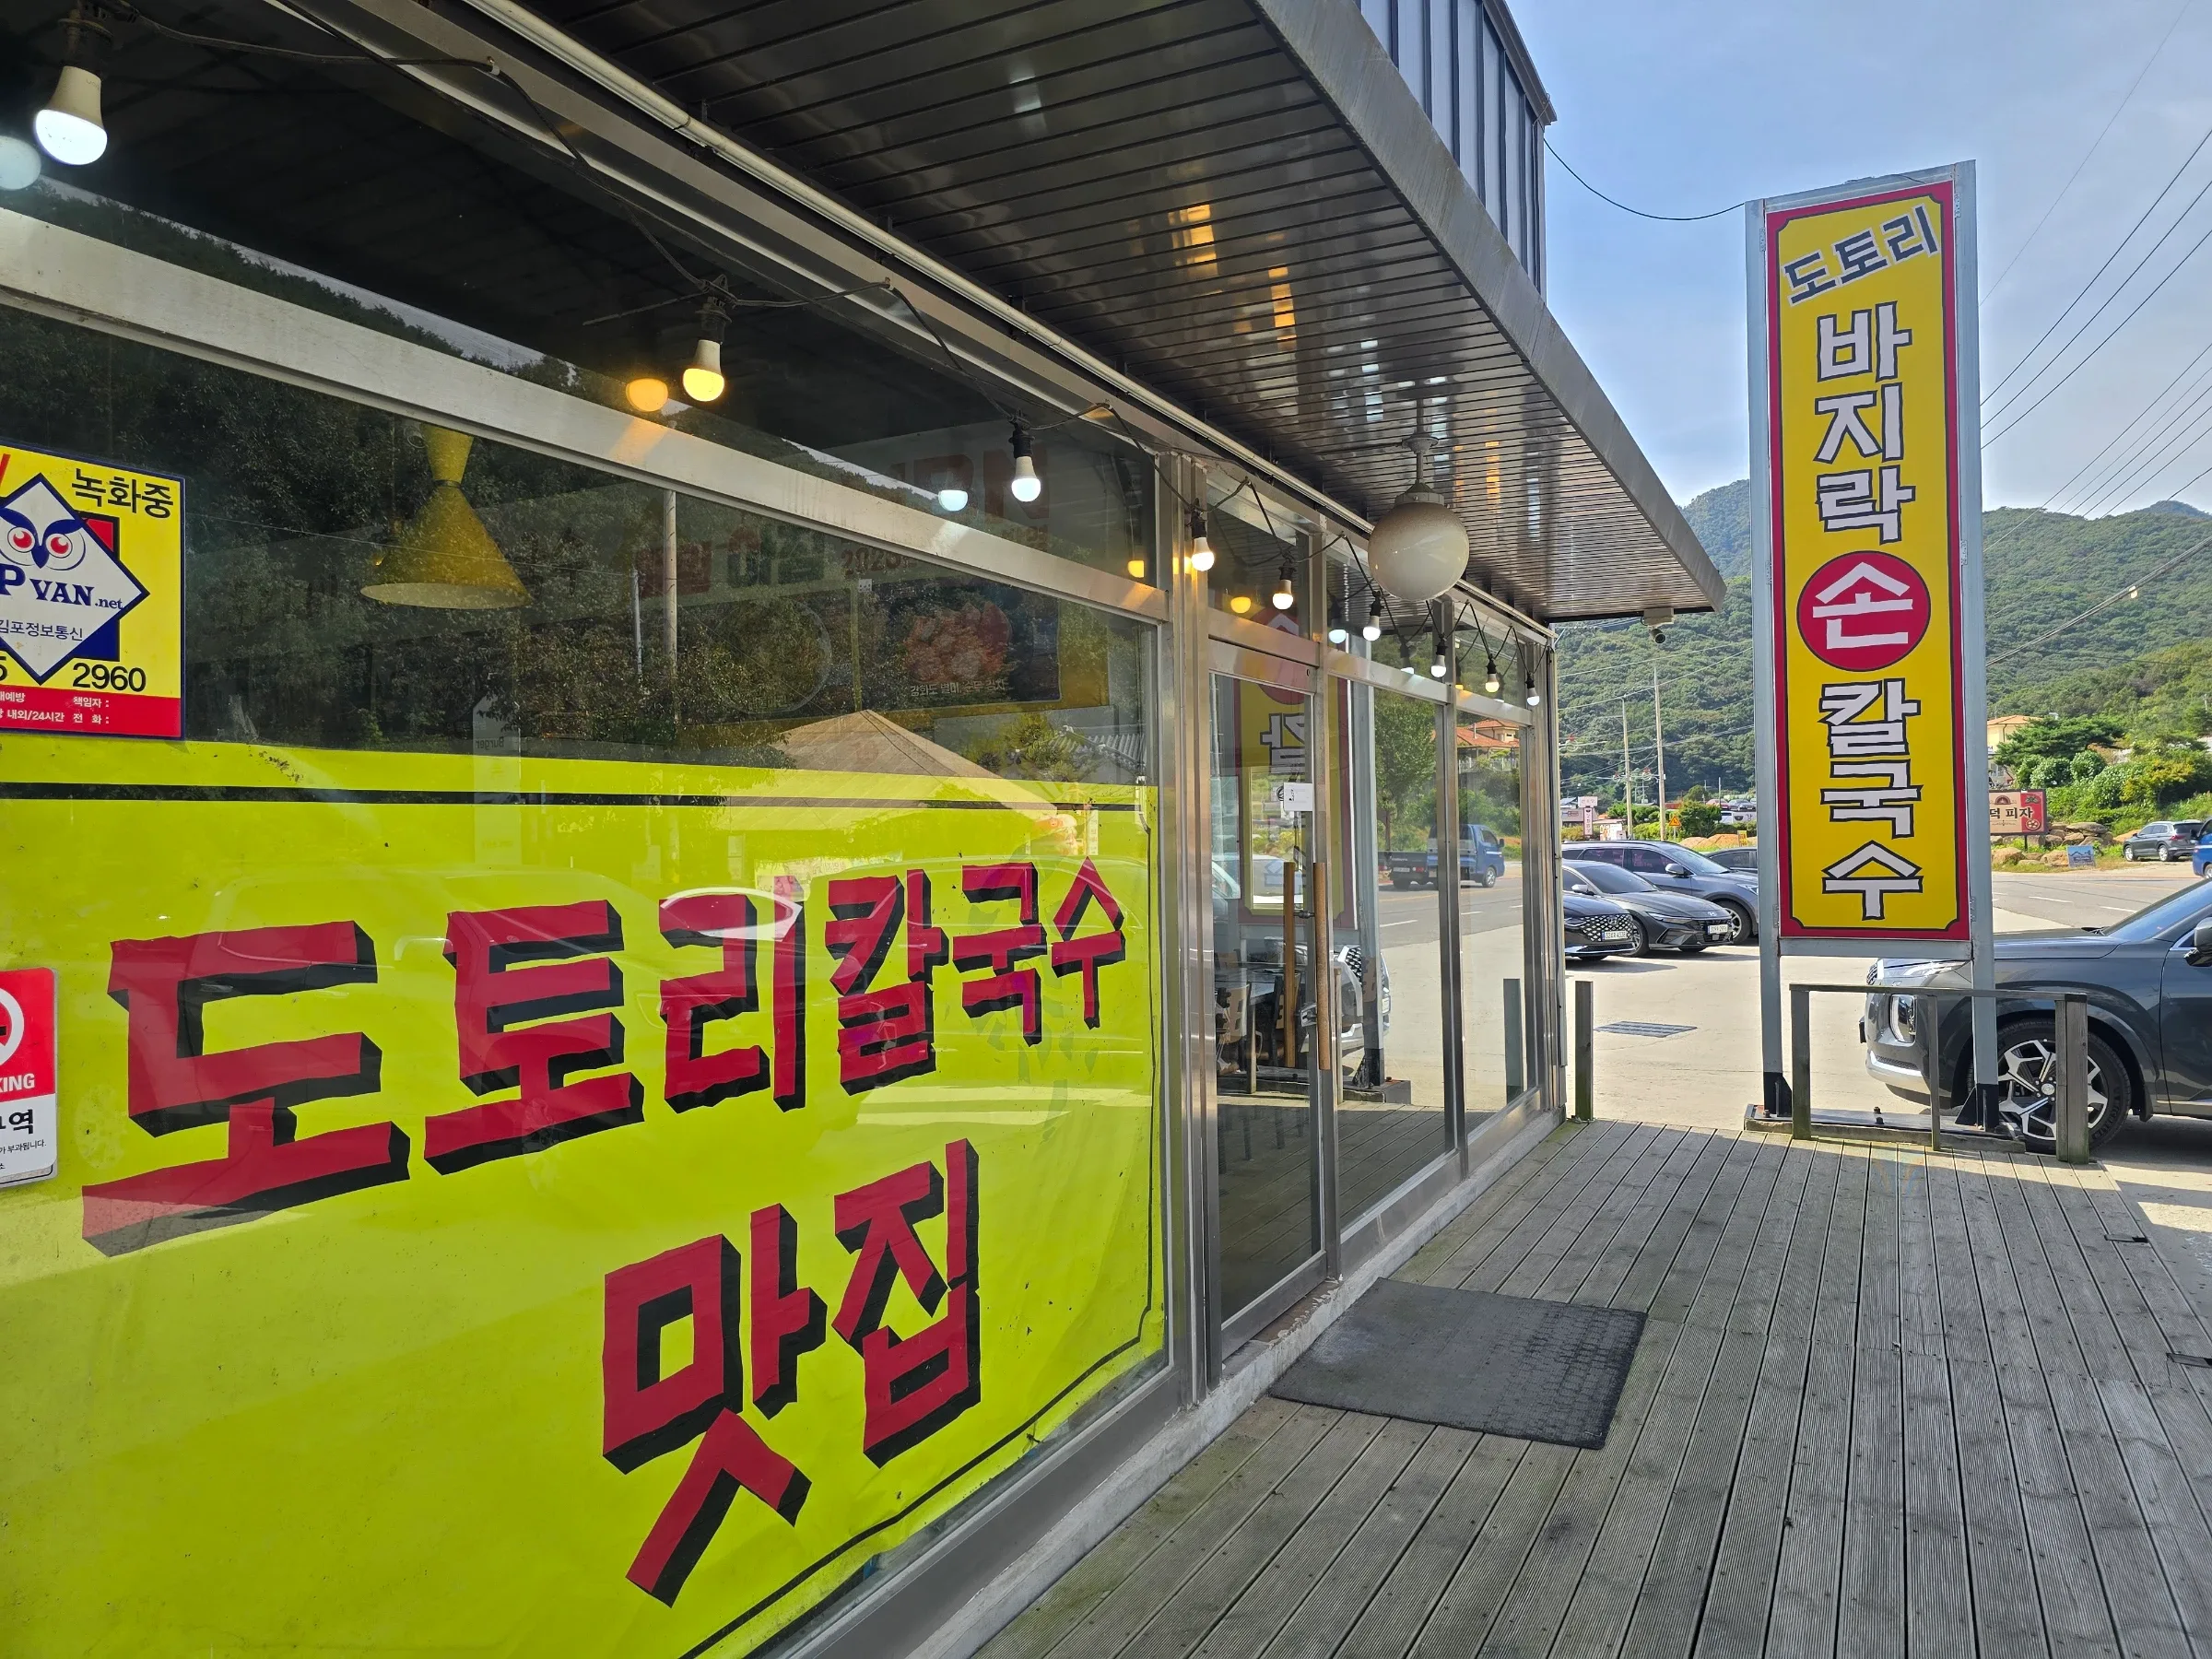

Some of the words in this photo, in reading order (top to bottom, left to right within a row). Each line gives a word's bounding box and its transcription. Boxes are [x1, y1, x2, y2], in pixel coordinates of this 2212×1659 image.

[1781, 204, 1940, 307] 도토리
[1813, 300, 1916, 545] 바지락
[71, 468, 174, 519] 녹화중
[1812, 561, 1913, 650] 손
[0, 619, 83, 641] 김포정보통신
[72, 663, 147, 691] 2960
[7, 709, 65, 723] 내외/24시간
[73, 696, 102, 708] 책임자
[1818, 677, 1924, 921] 칼국수
[2006, 806, 2033, 819] 피자
[0, 1109, 33, 1135] 역
[7, 1138, 47, 1153] 부과됩니다.
[602, 1137, 982, 1606] 맛집
